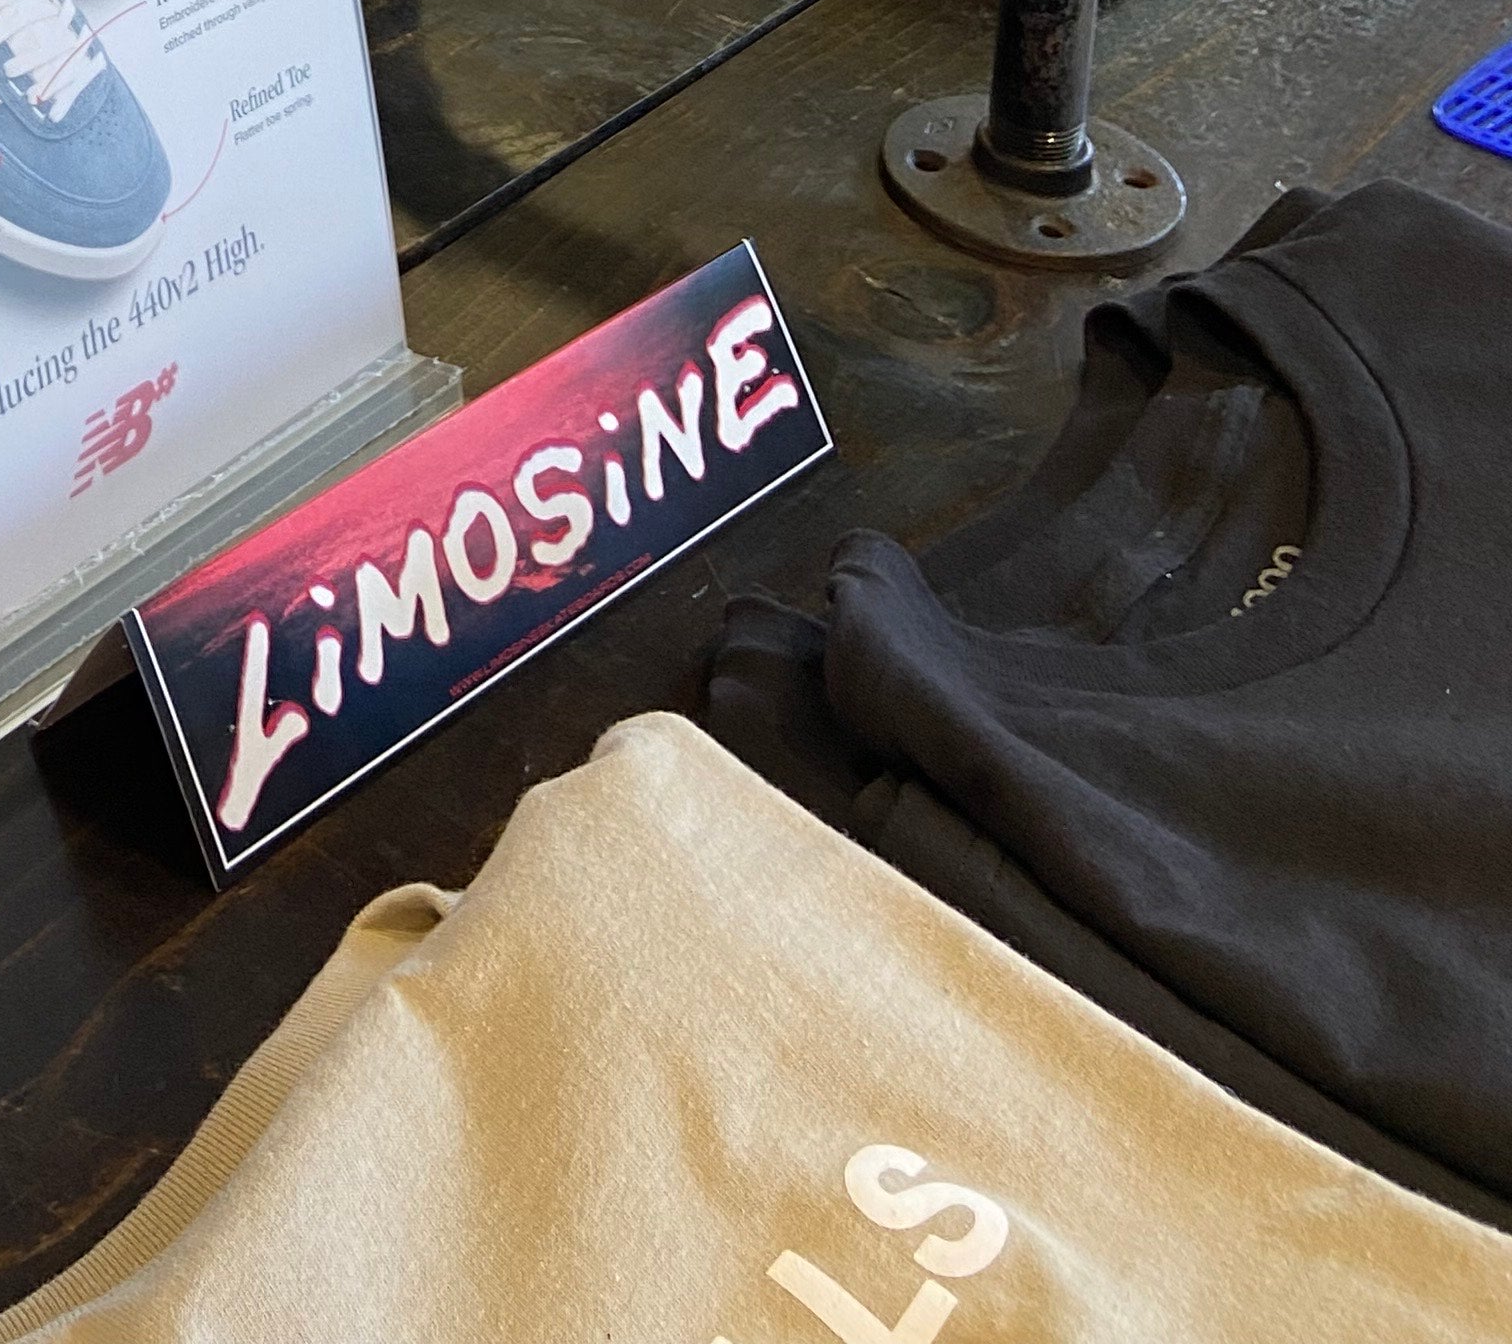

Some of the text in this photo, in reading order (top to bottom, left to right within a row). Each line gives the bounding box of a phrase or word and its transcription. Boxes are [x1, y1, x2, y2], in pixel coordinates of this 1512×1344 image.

[163, 23, 203, 54] stitched
[203, 3, 242, 32] through
[230, 63, 312, 123] Refined Toe
[234, 120, 265, 146] Flatter
[266, 112, 282, 128] toe
[81, 312, 123, 361] the
[127, 259, 200, 330] 440v2
[202, 223, 266, 284] High.
